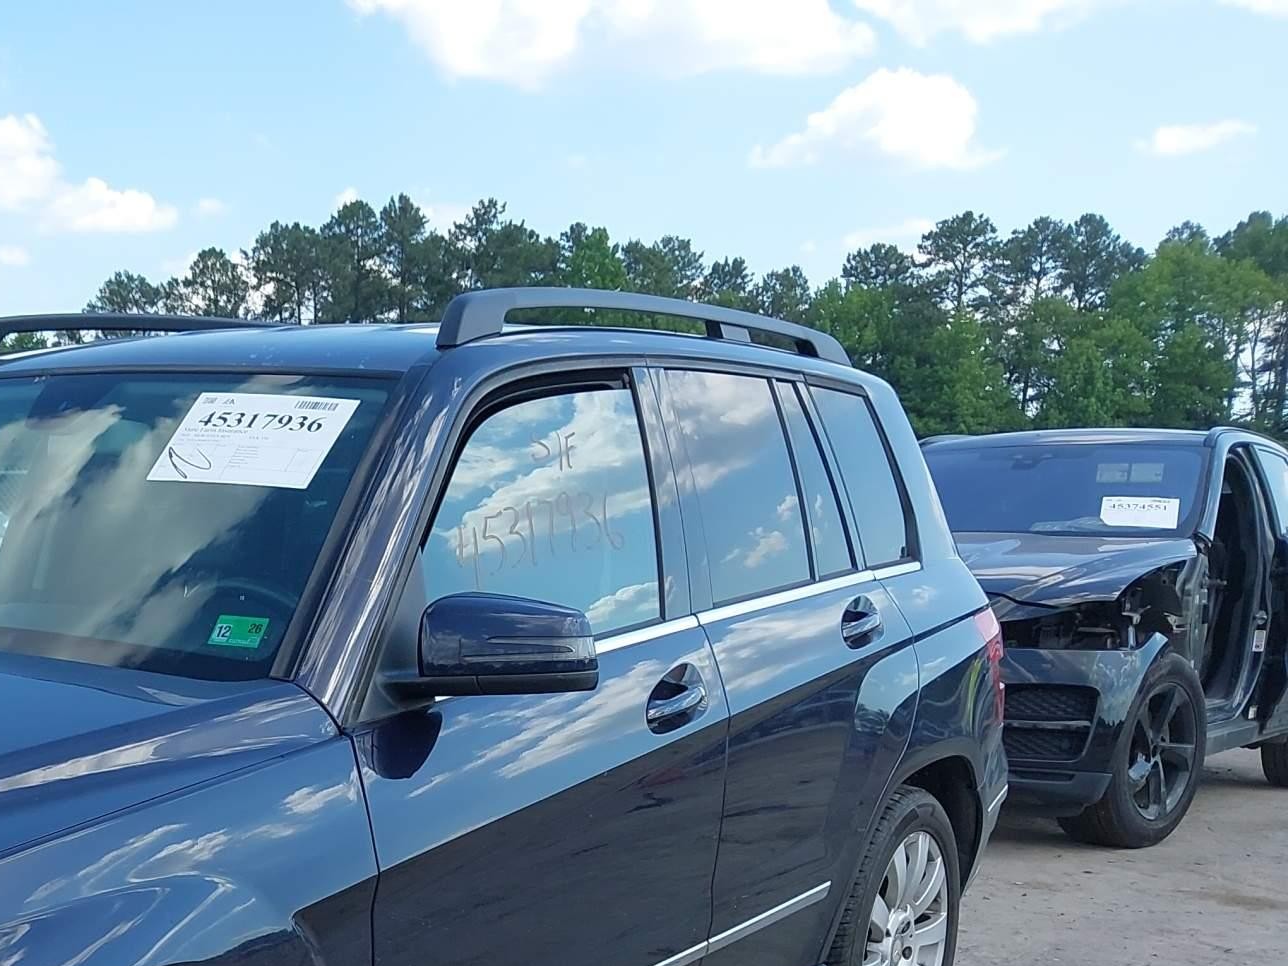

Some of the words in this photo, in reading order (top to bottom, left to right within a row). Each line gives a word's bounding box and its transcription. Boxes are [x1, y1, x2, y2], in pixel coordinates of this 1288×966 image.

[198, 411, 327, 433] 45317936
[455, 491, 625, 589] 45317936
[216, 625, 231, 637] 12
